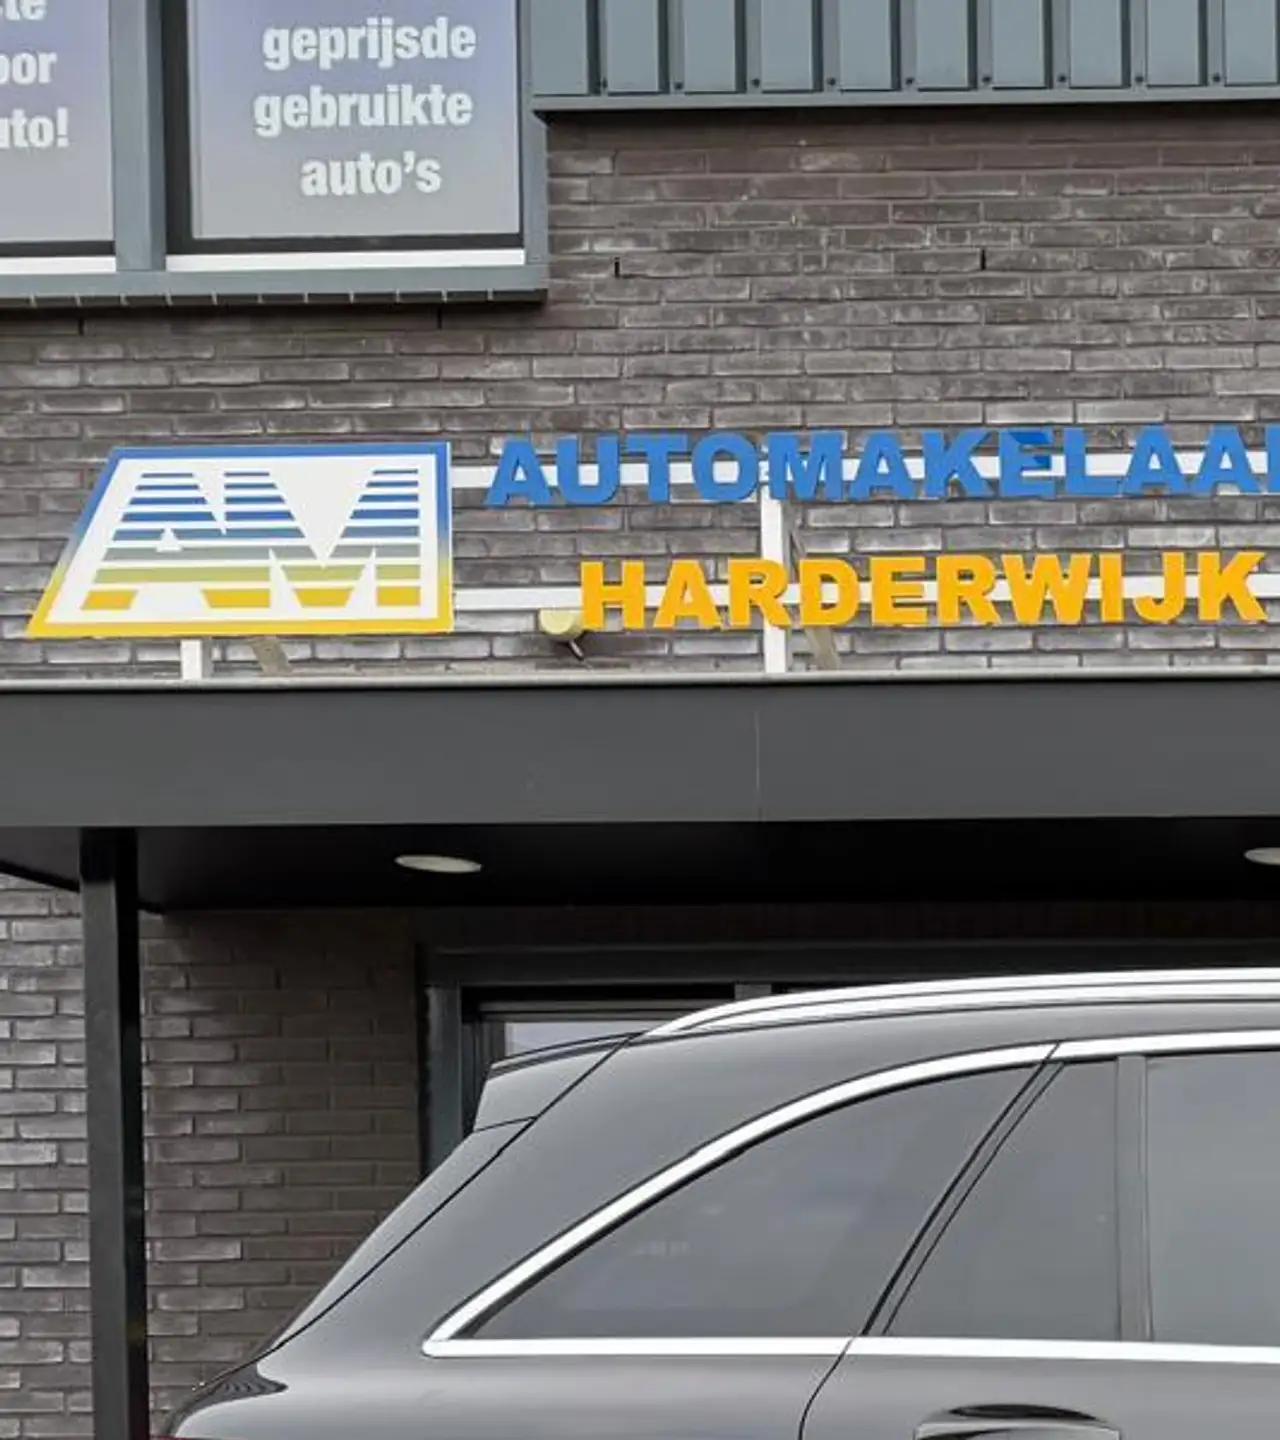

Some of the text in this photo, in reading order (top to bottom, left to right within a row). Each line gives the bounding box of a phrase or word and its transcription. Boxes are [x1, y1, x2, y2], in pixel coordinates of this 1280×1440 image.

[262, 16, 477, 71] geprijsde
[253, 84, 473, 138] gebruikte
[300, 151, 443, 197] auto's
[575, 550, 1269, 631] HARDERWIJK
